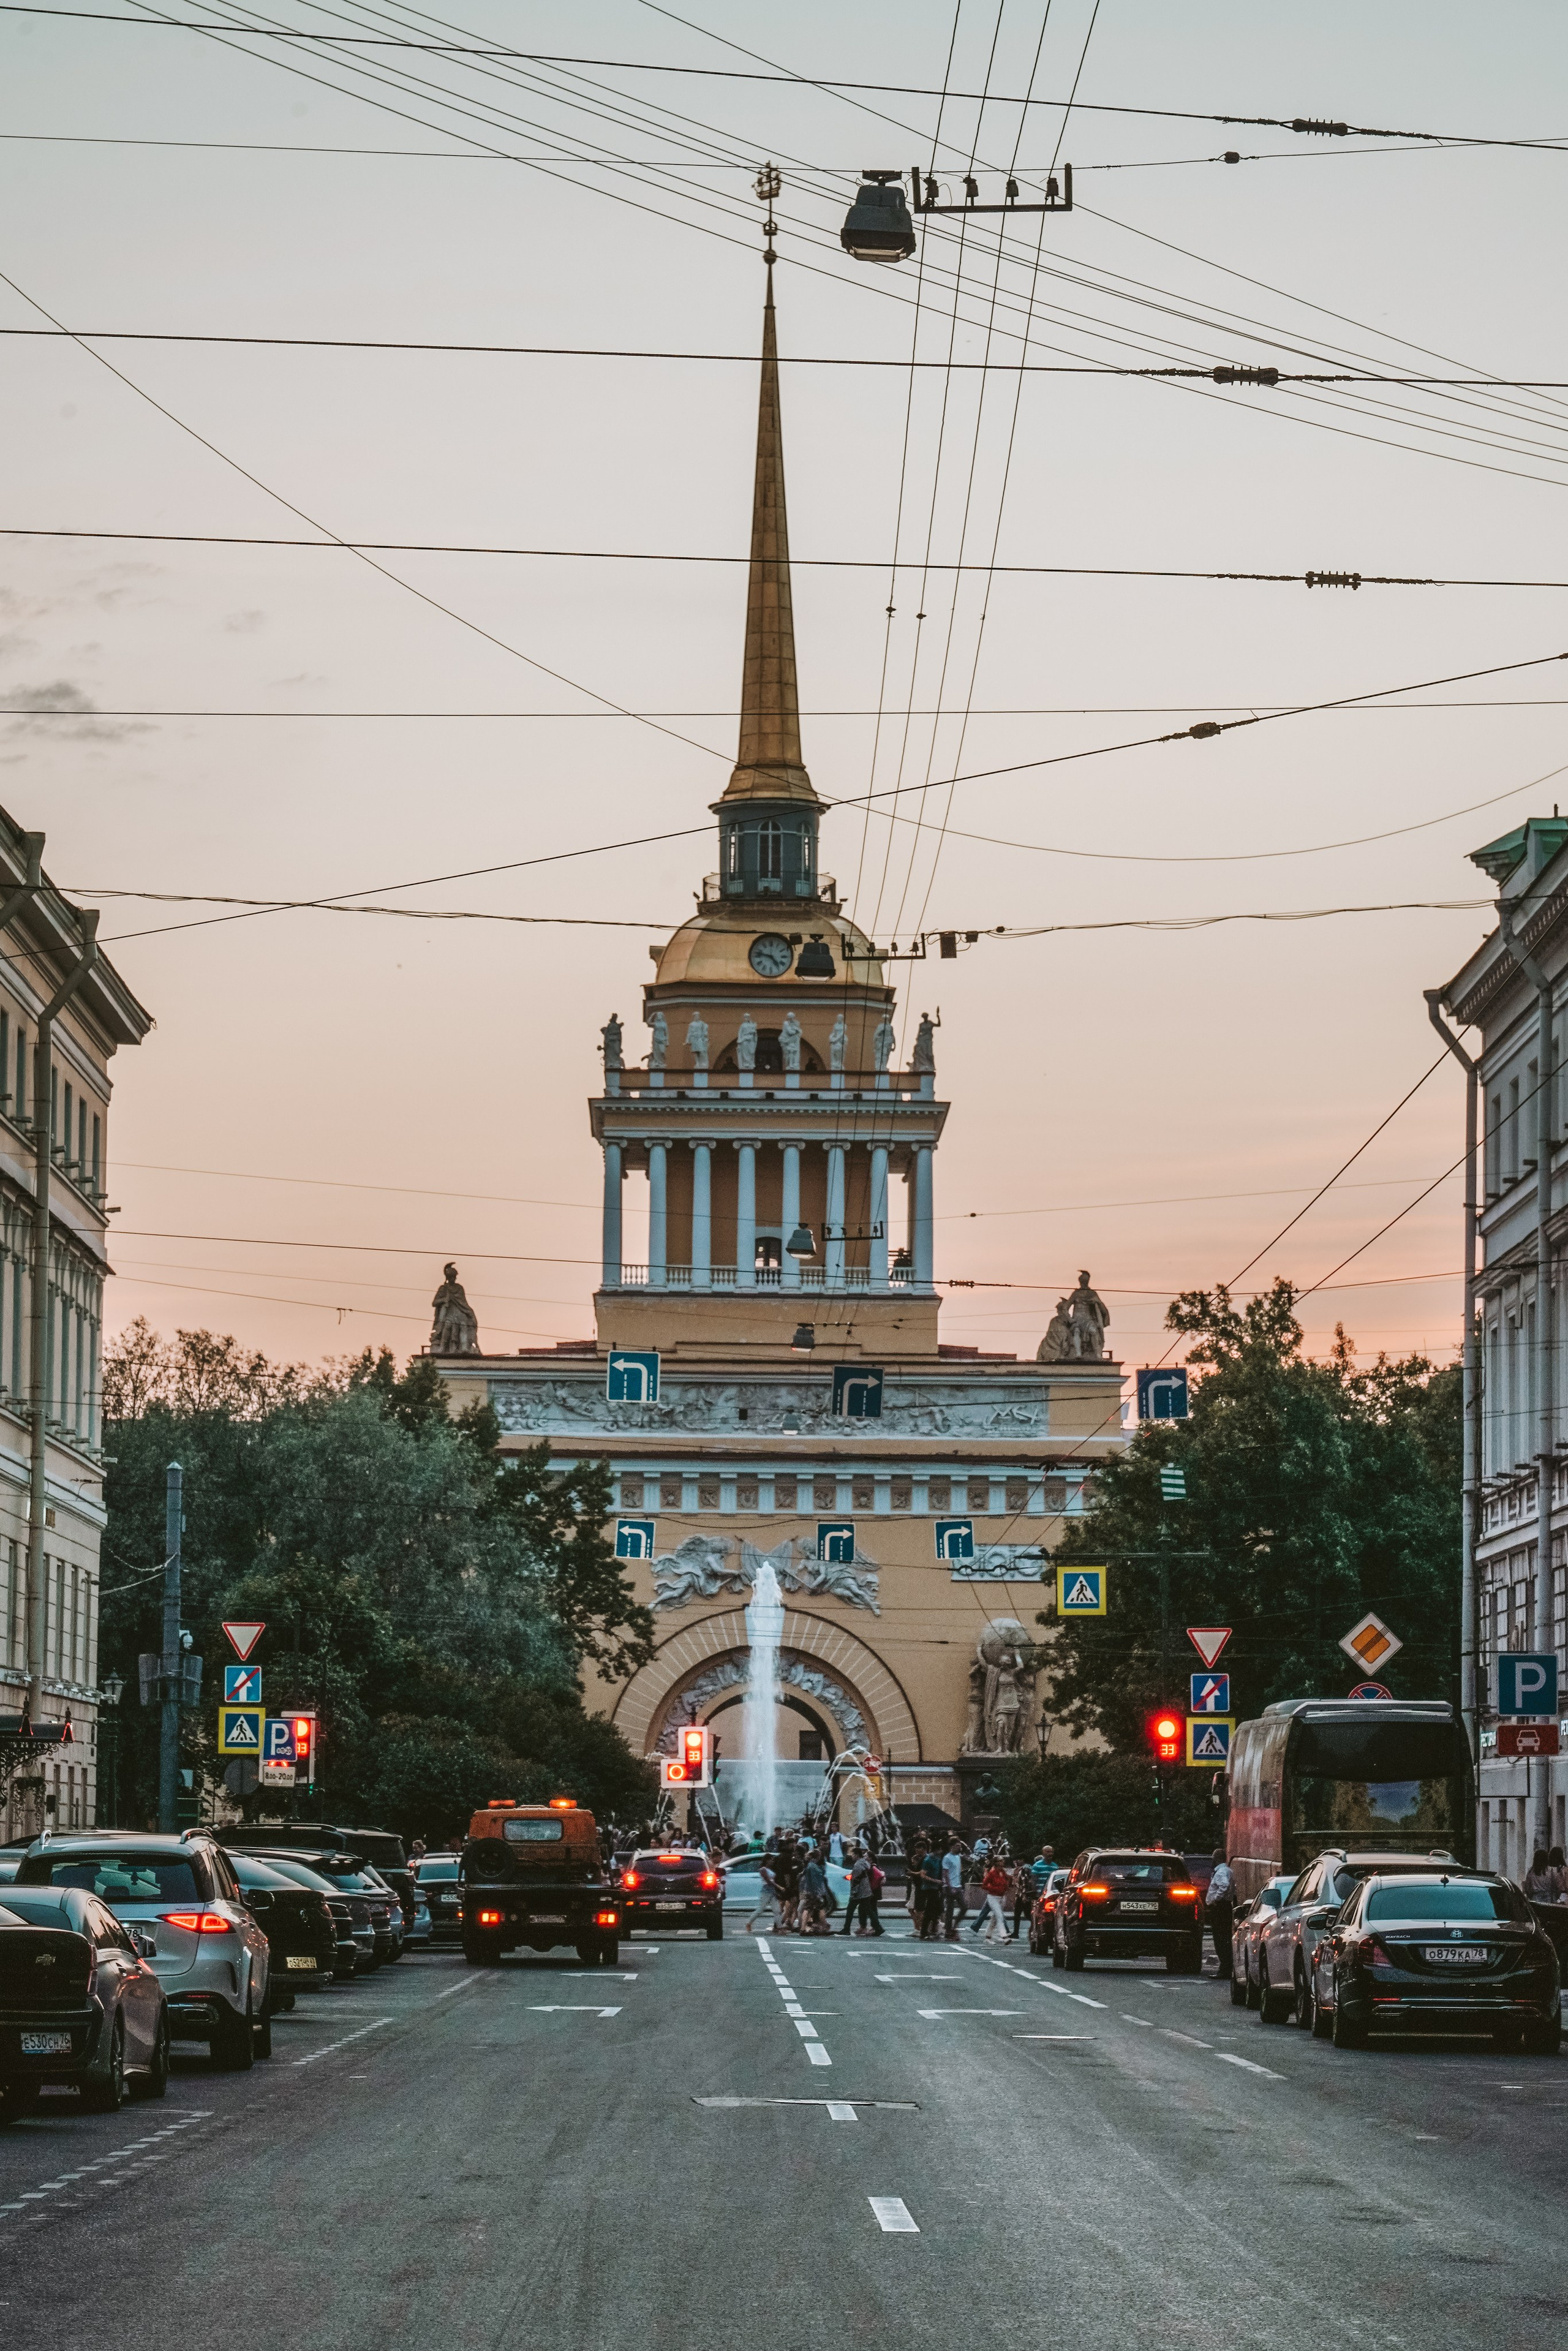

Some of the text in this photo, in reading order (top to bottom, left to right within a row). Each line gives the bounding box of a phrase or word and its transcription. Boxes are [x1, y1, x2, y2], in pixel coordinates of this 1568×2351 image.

[1515, 1662, 1546, 1708] P
[271, 1724, 289, 1756] P
[1162, 1745, 1174, 1755] 33
[689, 1751, 699, 1760] 33
